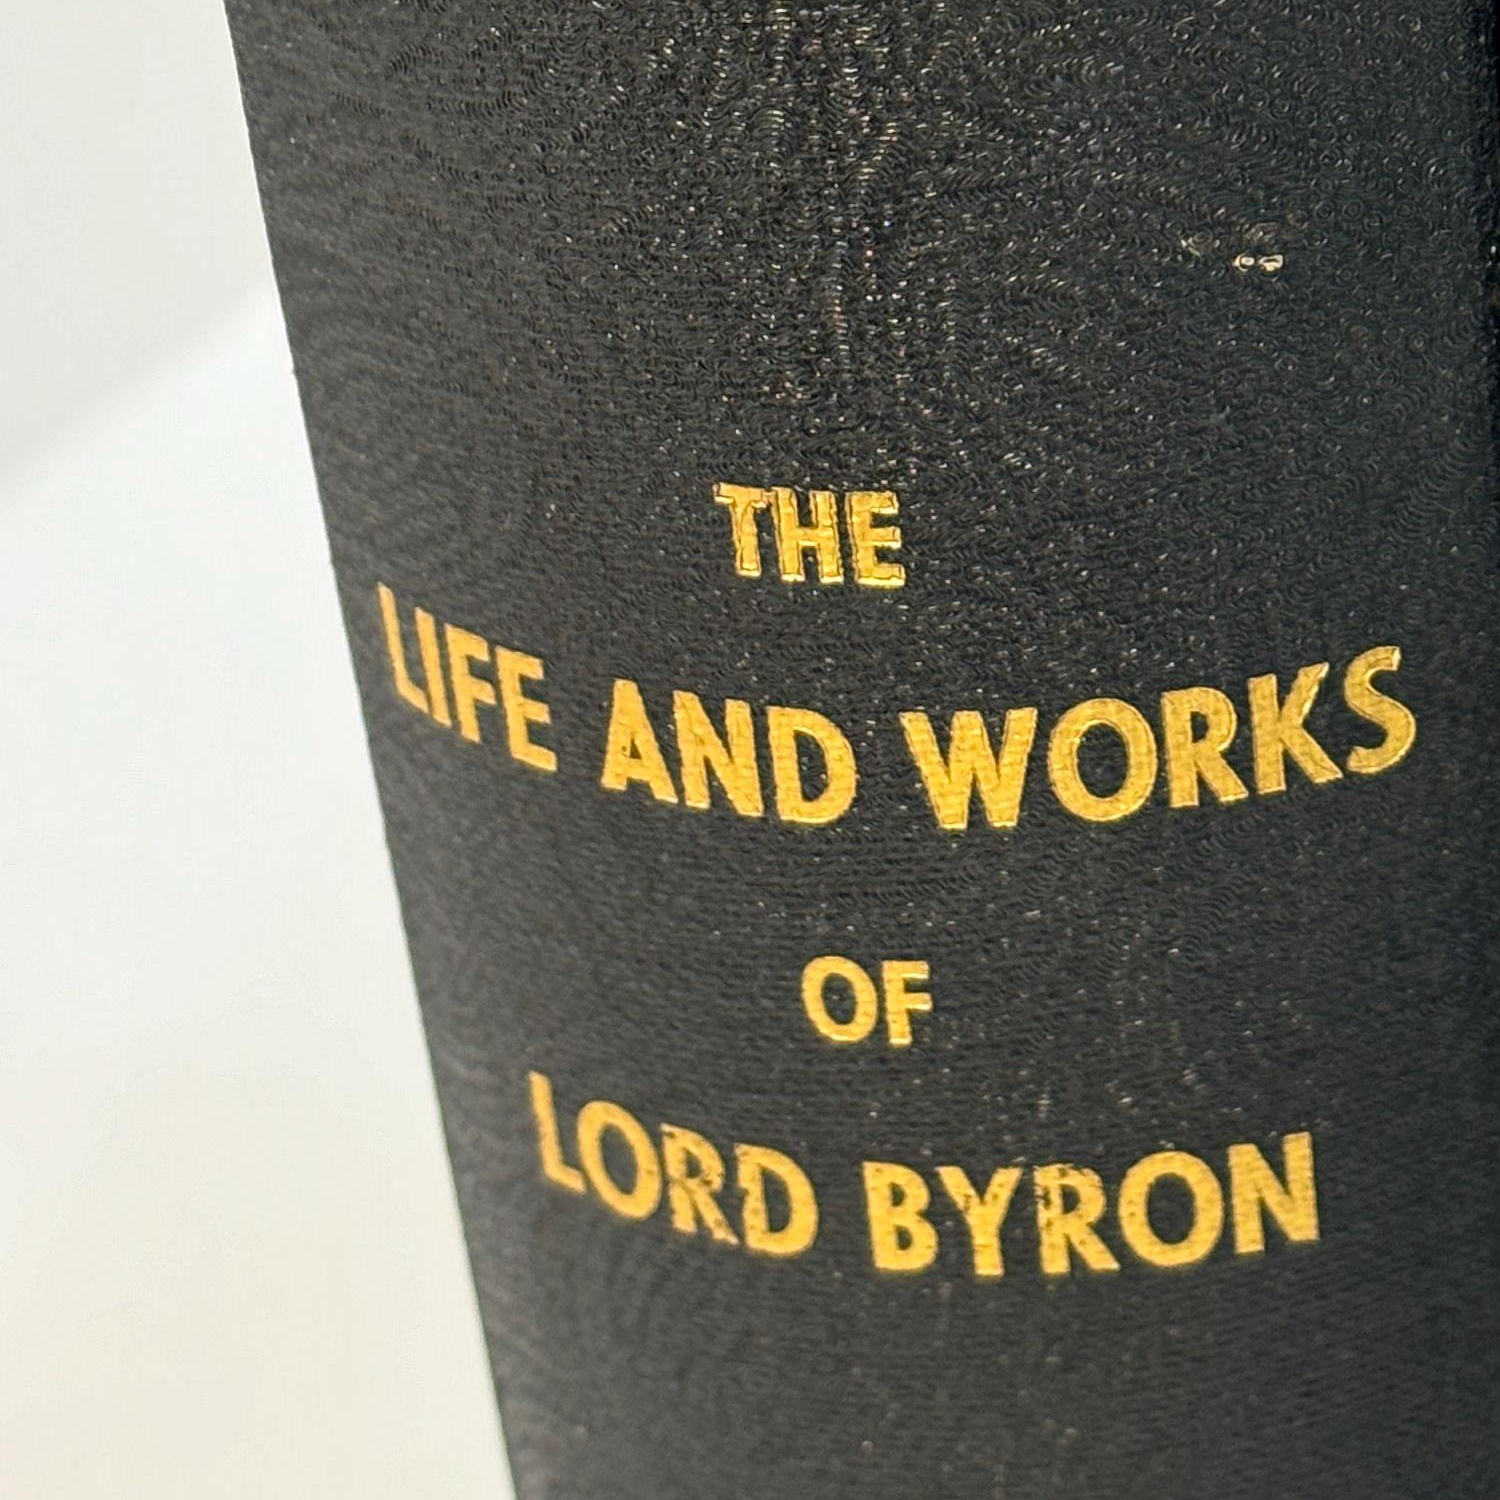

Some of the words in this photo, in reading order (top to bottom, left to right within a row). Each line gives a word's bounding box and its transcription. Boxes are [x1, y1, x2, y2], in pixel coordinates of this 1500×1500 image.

[714, 482, 906, 588] THE
[376, 586, 559, 774] LIFE
[600, 678, 859, 826] AND
[901, 645, 1418, 831] WORKS
[800, 954, 934, 1047] OF
[526, 1072, 820, 1260] LORD
[861, 1131, 1320, 1279] BYRON
